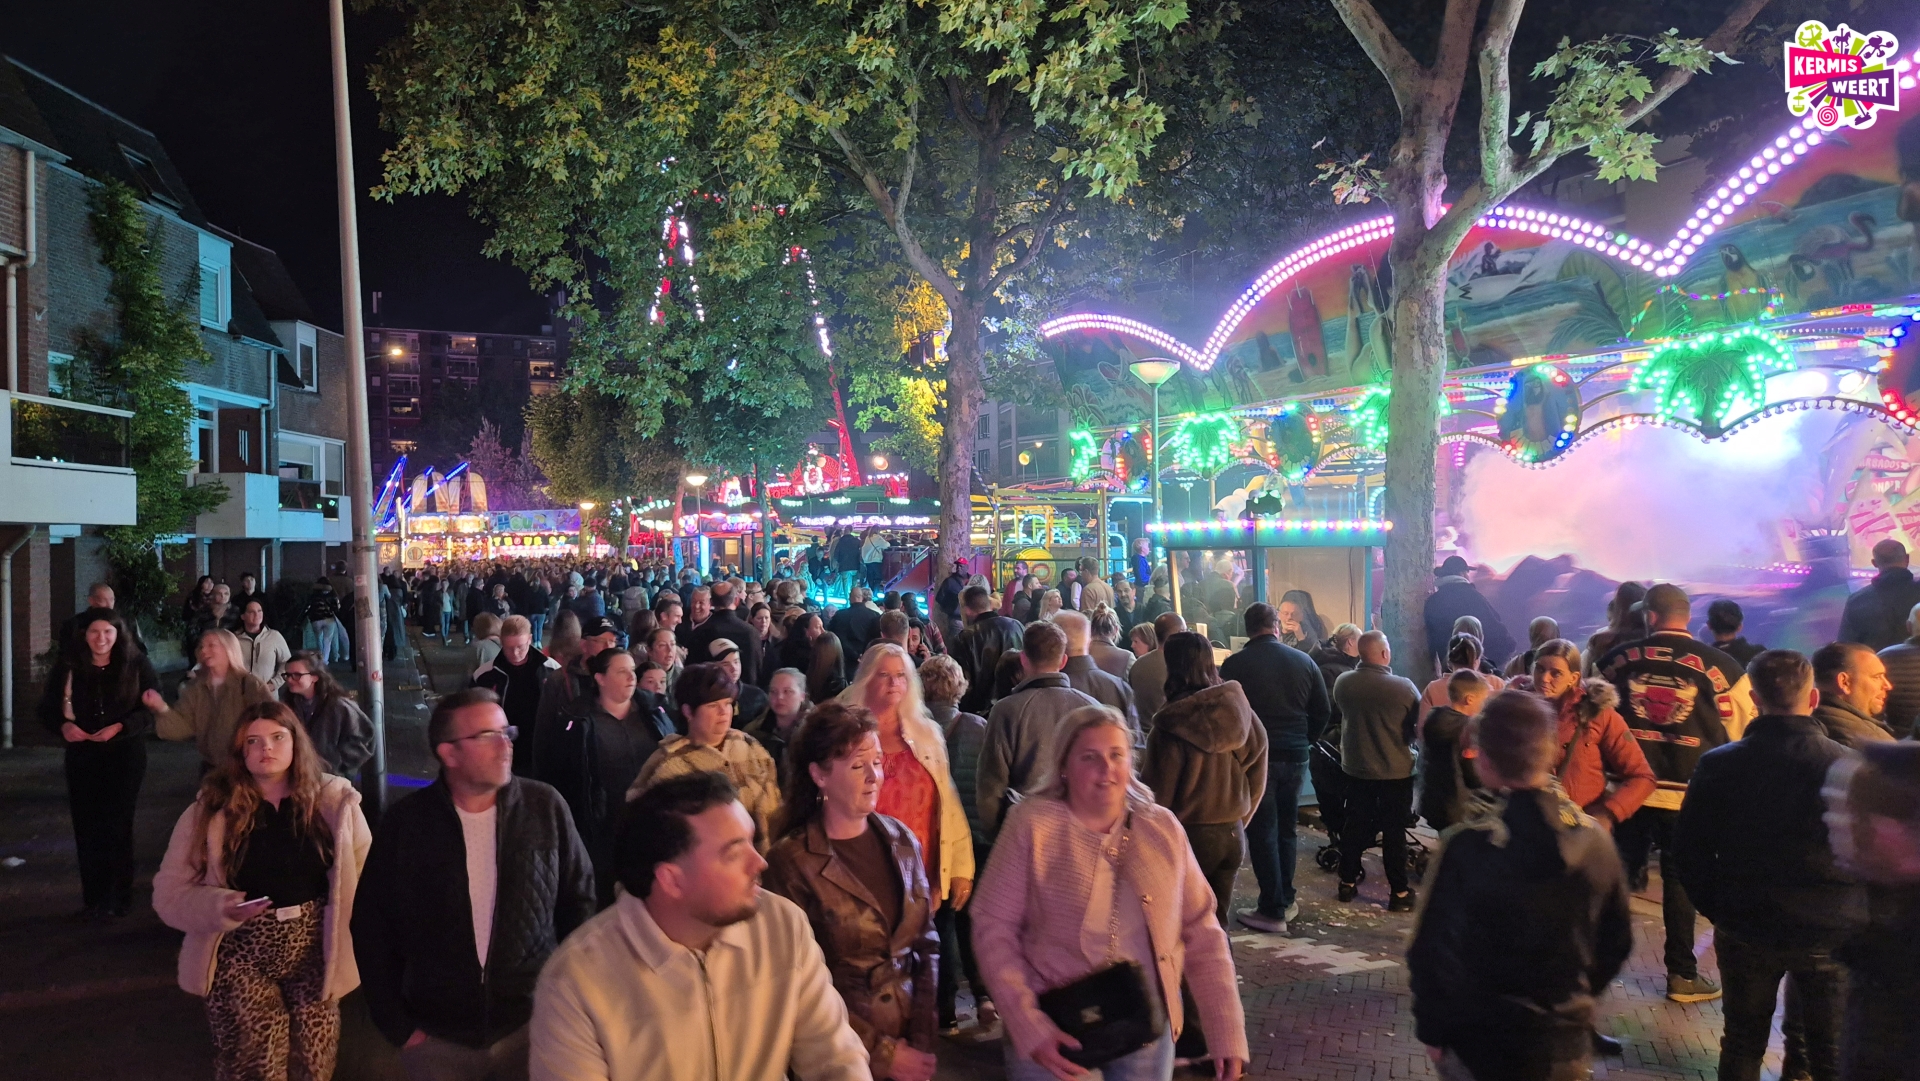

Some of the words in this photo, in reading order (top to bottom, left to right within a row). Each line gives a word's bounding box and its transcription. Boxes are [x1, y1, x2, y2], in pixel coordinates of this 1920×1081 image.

[1858, 459, 1900, 469] ARBADOS
[721, 522, 758, 531] COASTER
[1602, 645, 1734, 718] ICAGO
